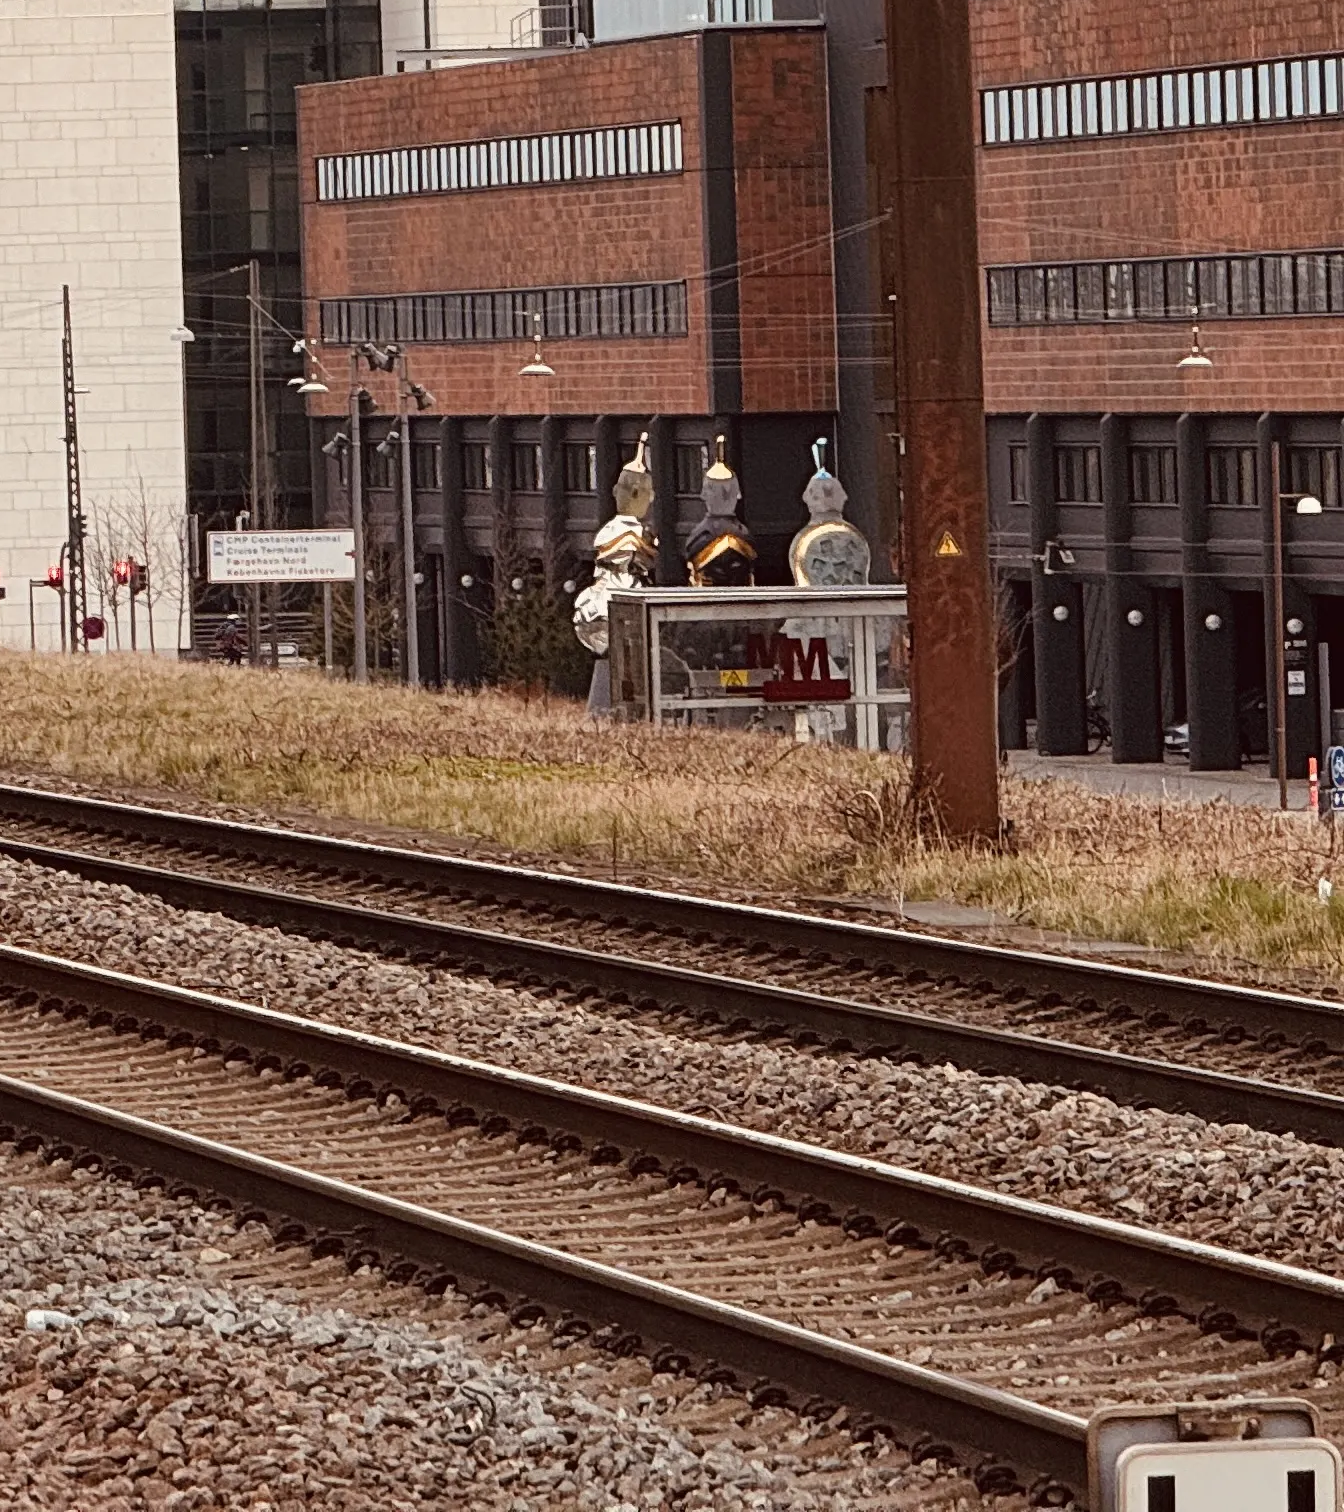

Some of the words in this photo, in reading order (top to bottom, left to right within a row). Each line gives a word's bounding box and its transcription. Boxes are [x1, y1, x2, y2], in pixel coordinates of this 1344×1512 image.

[226, 536, 249, 545] CMP
[226, 547, 258, 555] Cruise
[261, 546, 309, 554] Terminals
[283, 556, 307, 565] Nord
[784, 637, 831, 681] M
